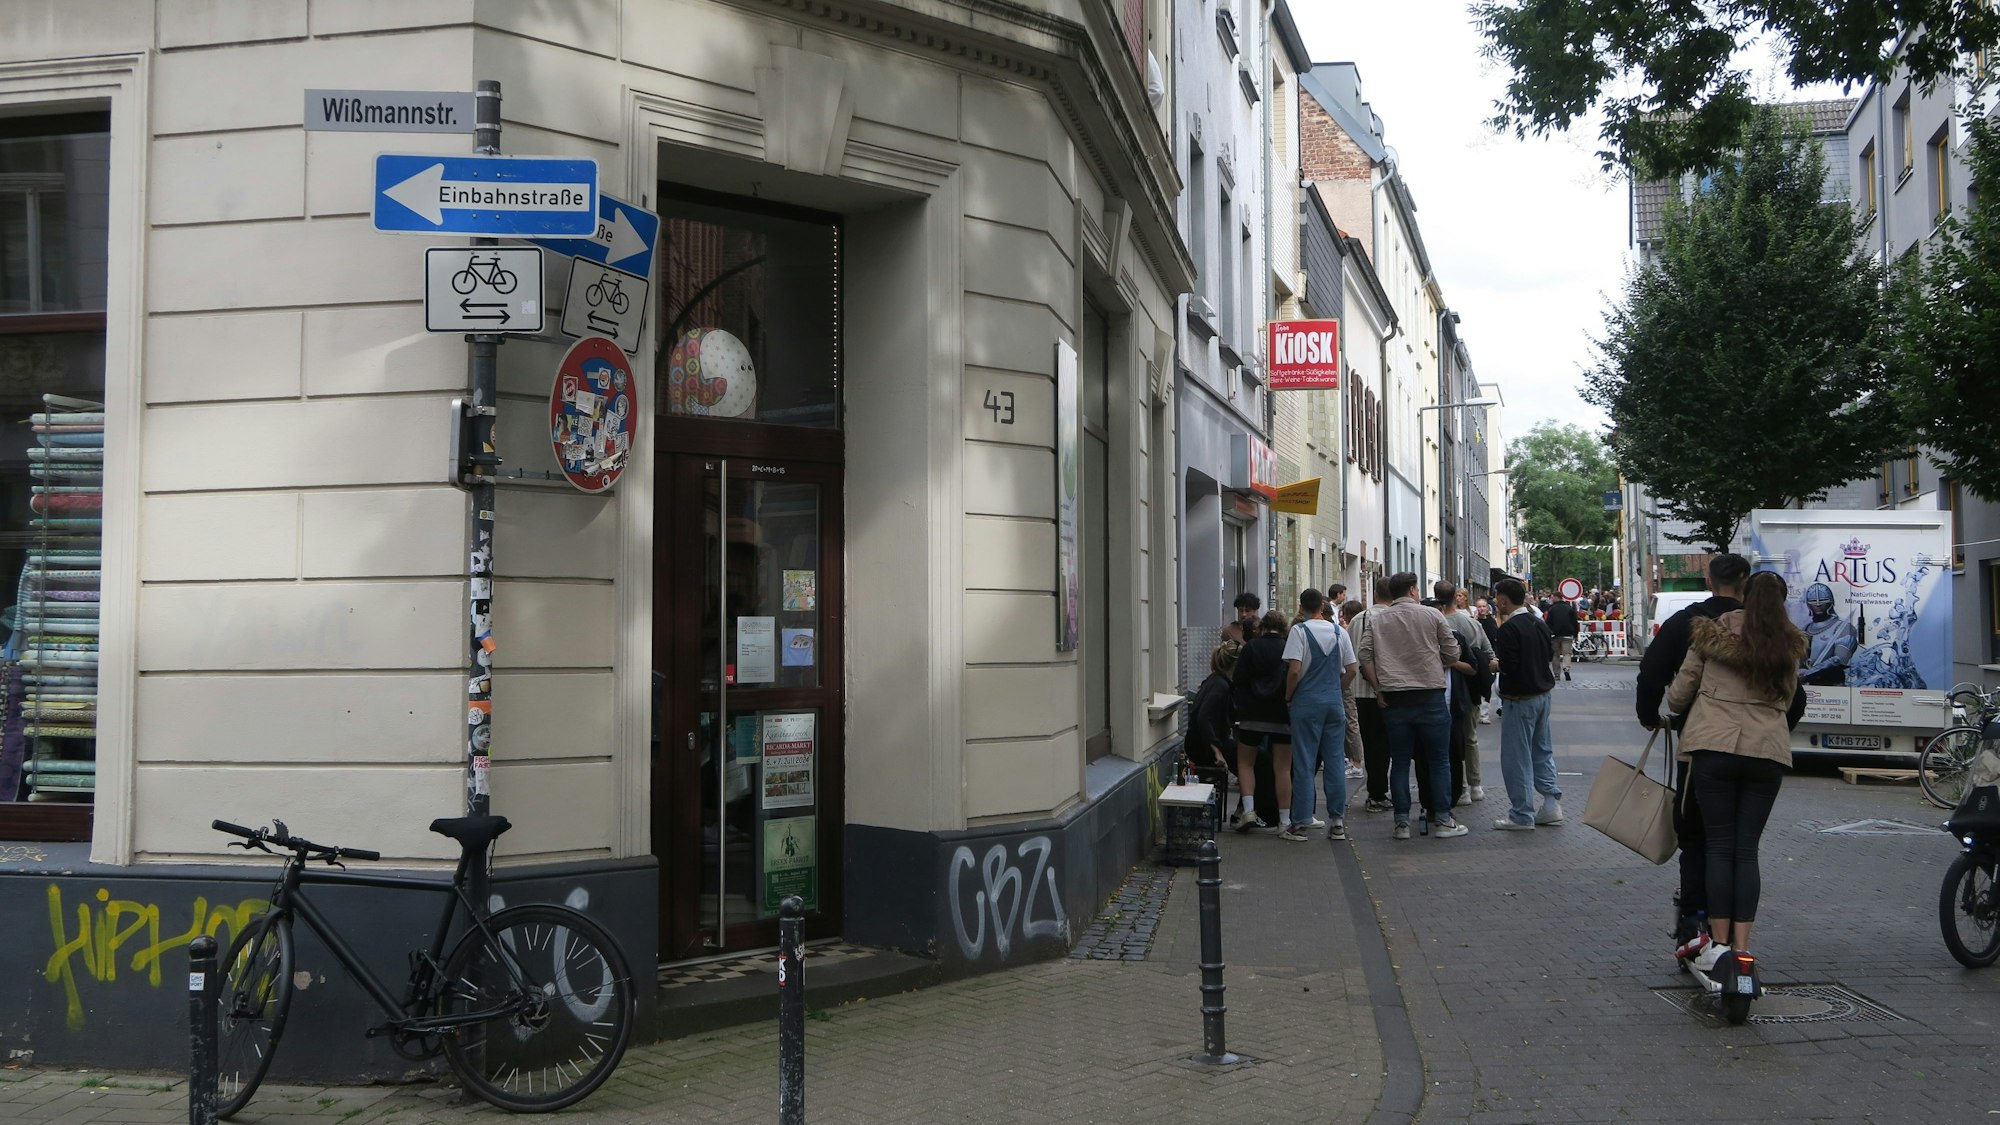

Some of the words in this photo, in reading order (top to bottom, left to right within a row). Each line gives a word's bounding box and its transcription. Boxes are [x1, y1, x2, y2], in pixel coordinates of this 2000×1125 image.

[322, 97, 458, 127] Wißmannstr.
[438, 186, 584, 206] Einbahnstraße
[983, 389, 1015, 424] 43
[1814, 557, 1896, 587] ARTUS
[1850, 590, 1889, 598] Natürliches
[1855, 737, 1879, 747] 7713
